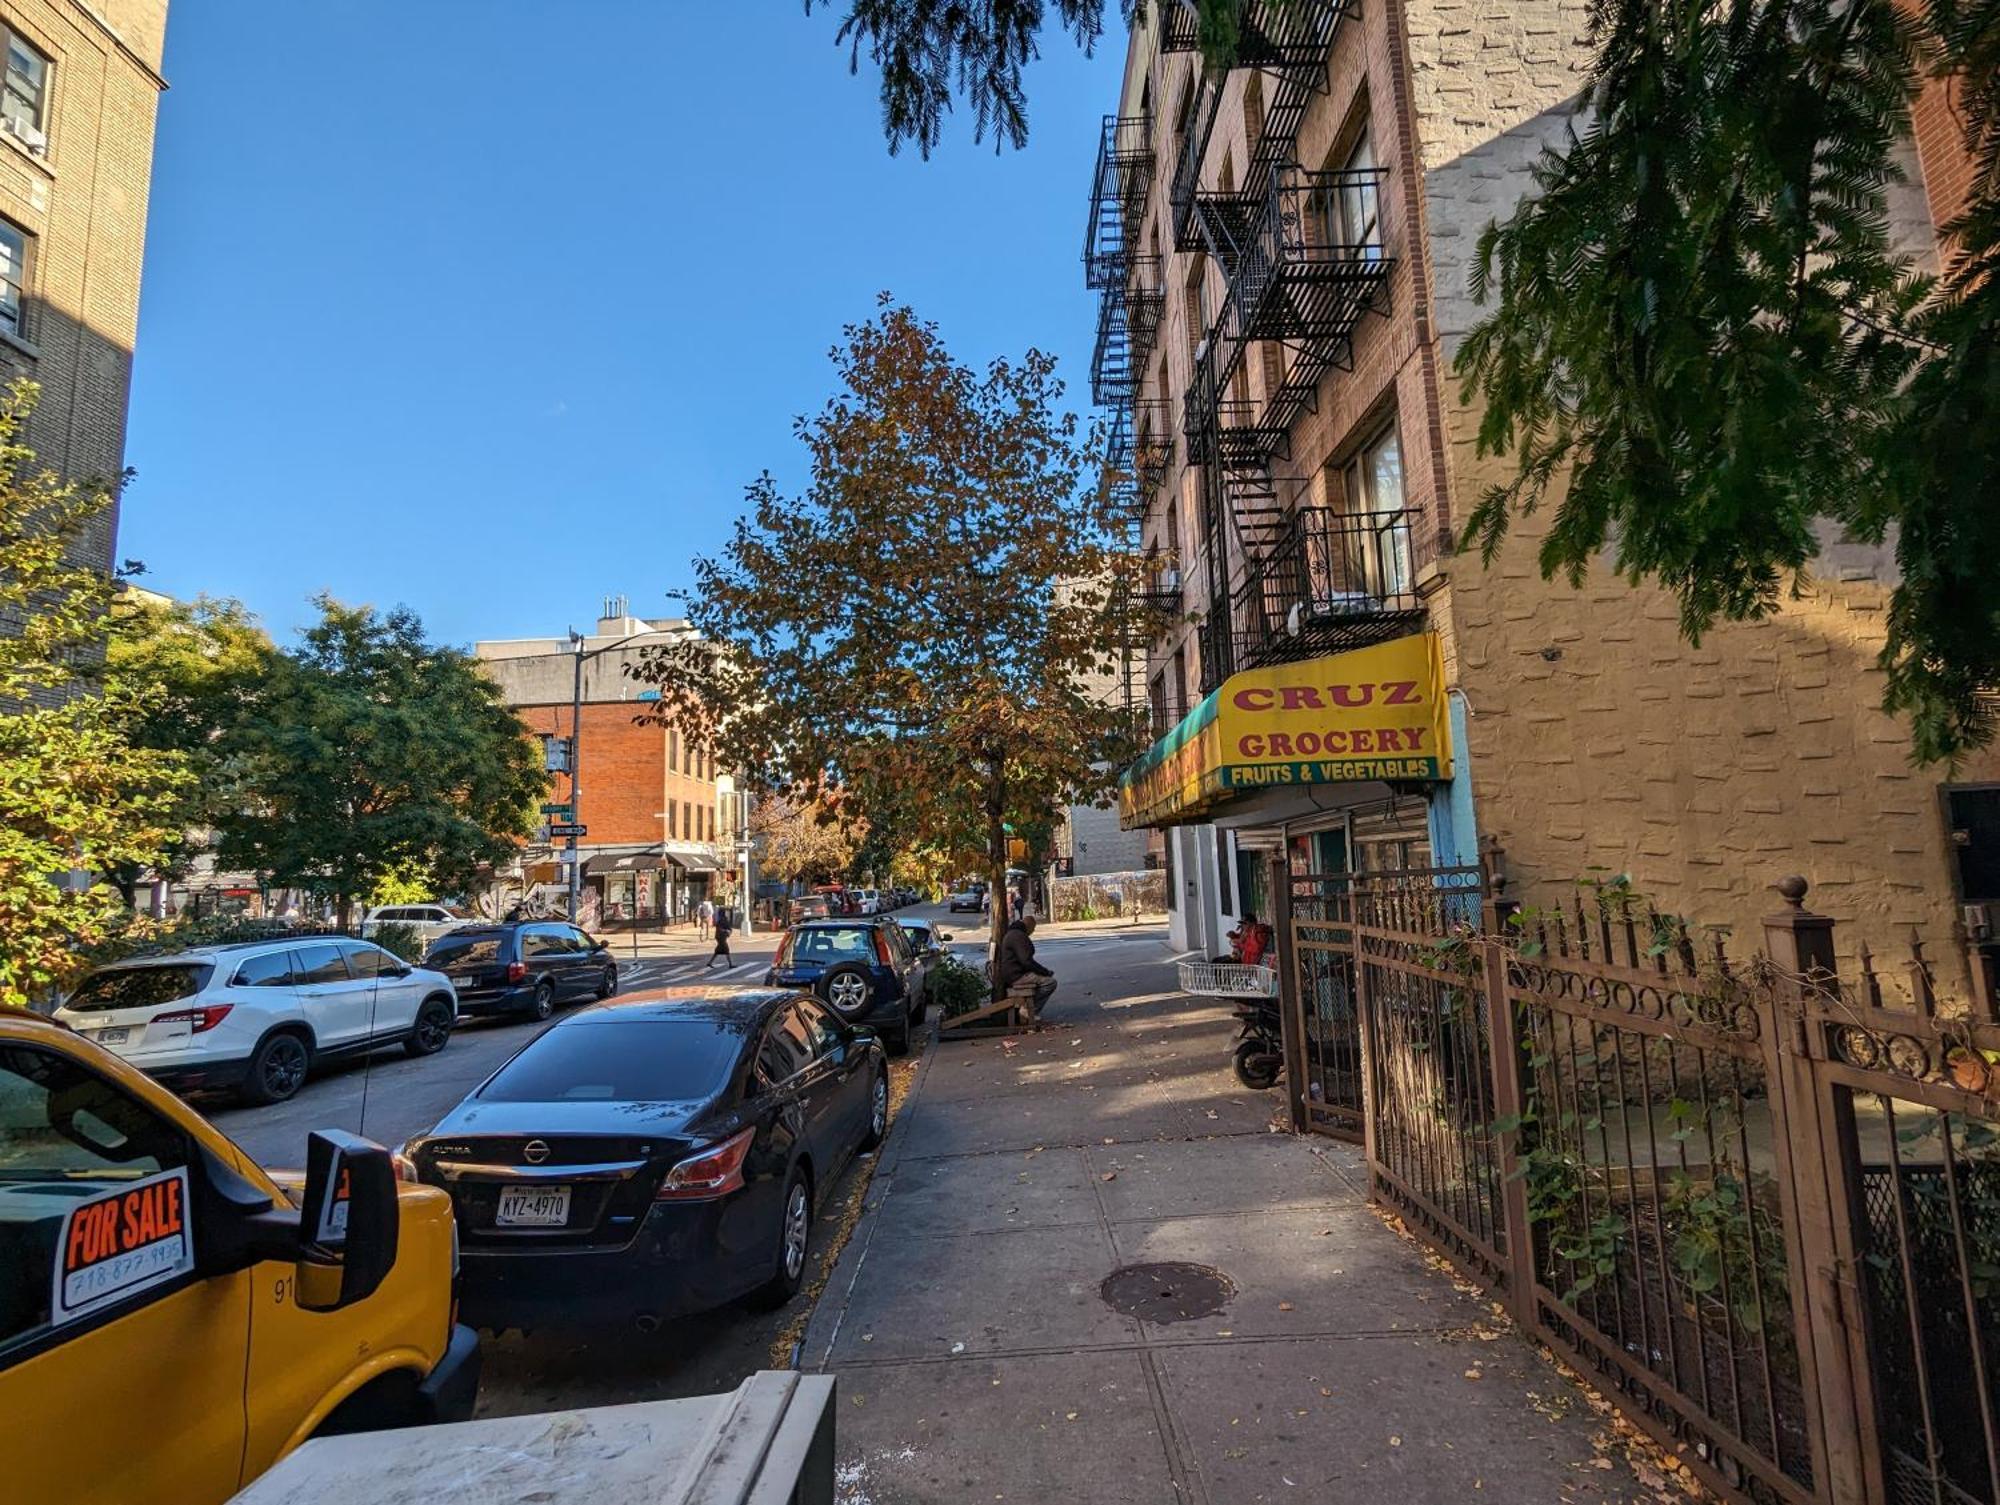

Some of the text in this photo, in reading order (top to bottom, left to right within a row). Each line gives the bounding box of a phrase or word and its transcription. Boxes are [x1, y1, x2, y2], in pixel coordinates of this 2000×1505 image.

[1232, 680, 1423, 711] CRUZ
[1238, 727, 1427, 758] GROCERY
[1232, 759, 1430, 785] FRUITS & VEGETABLES
[67, 1178, 181, 1271] FOR SALE
